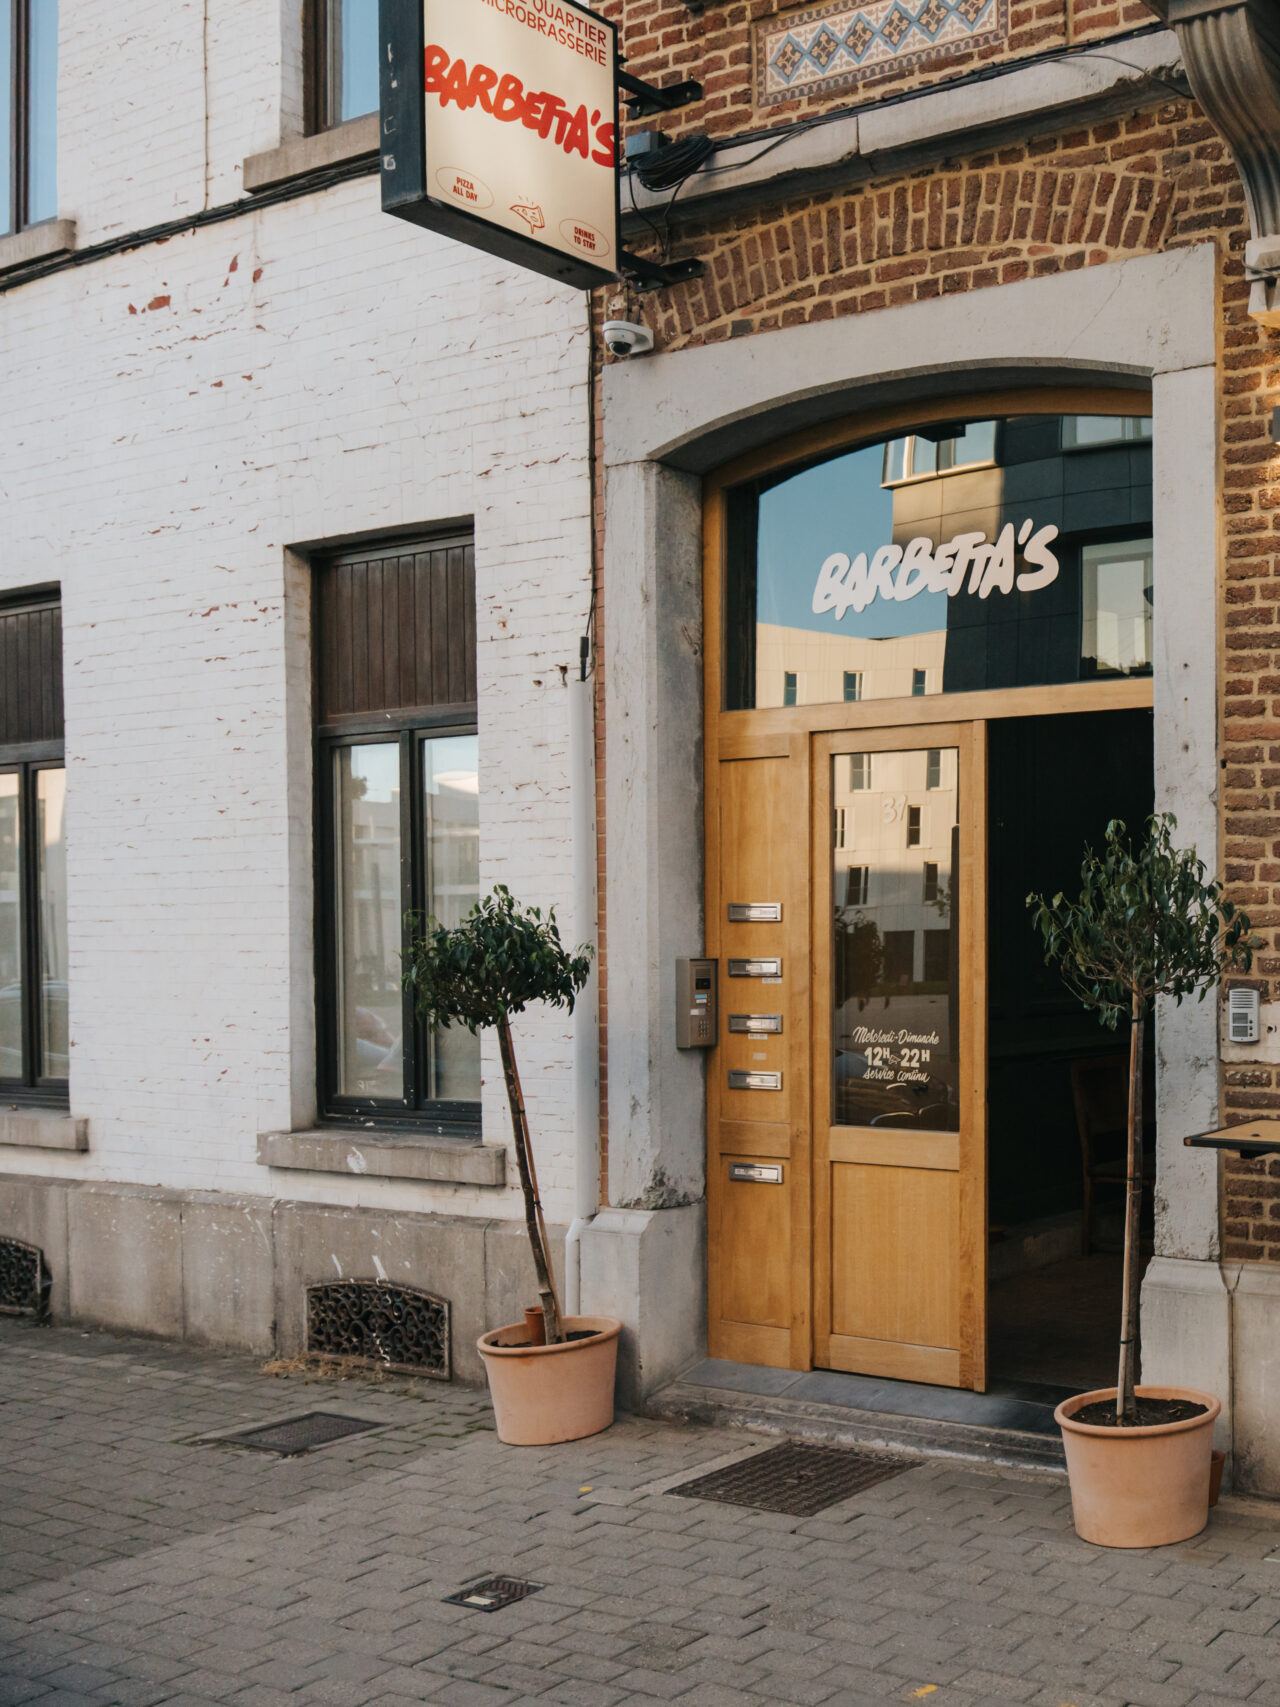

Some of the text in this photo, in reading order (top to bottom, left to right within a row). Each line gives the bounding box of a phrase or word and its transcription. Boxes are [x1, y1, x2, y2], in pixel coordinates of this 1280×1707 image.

[532, 0, 607, 48] QUARTIER
[424, 44, 614, 168] BARBETTA'S
[456, 176, 474, 191] PIZZA
[453, 185, 478, 202] ALL DAY
[574, 226, 595, 242] DRINKS
[574, 235, 596, 251] TO STAY
[812, 518, 1060, 621] BARBETTA'S
[881, 793, 908, 824] 31
[863, 1067, 894, 1080] service
